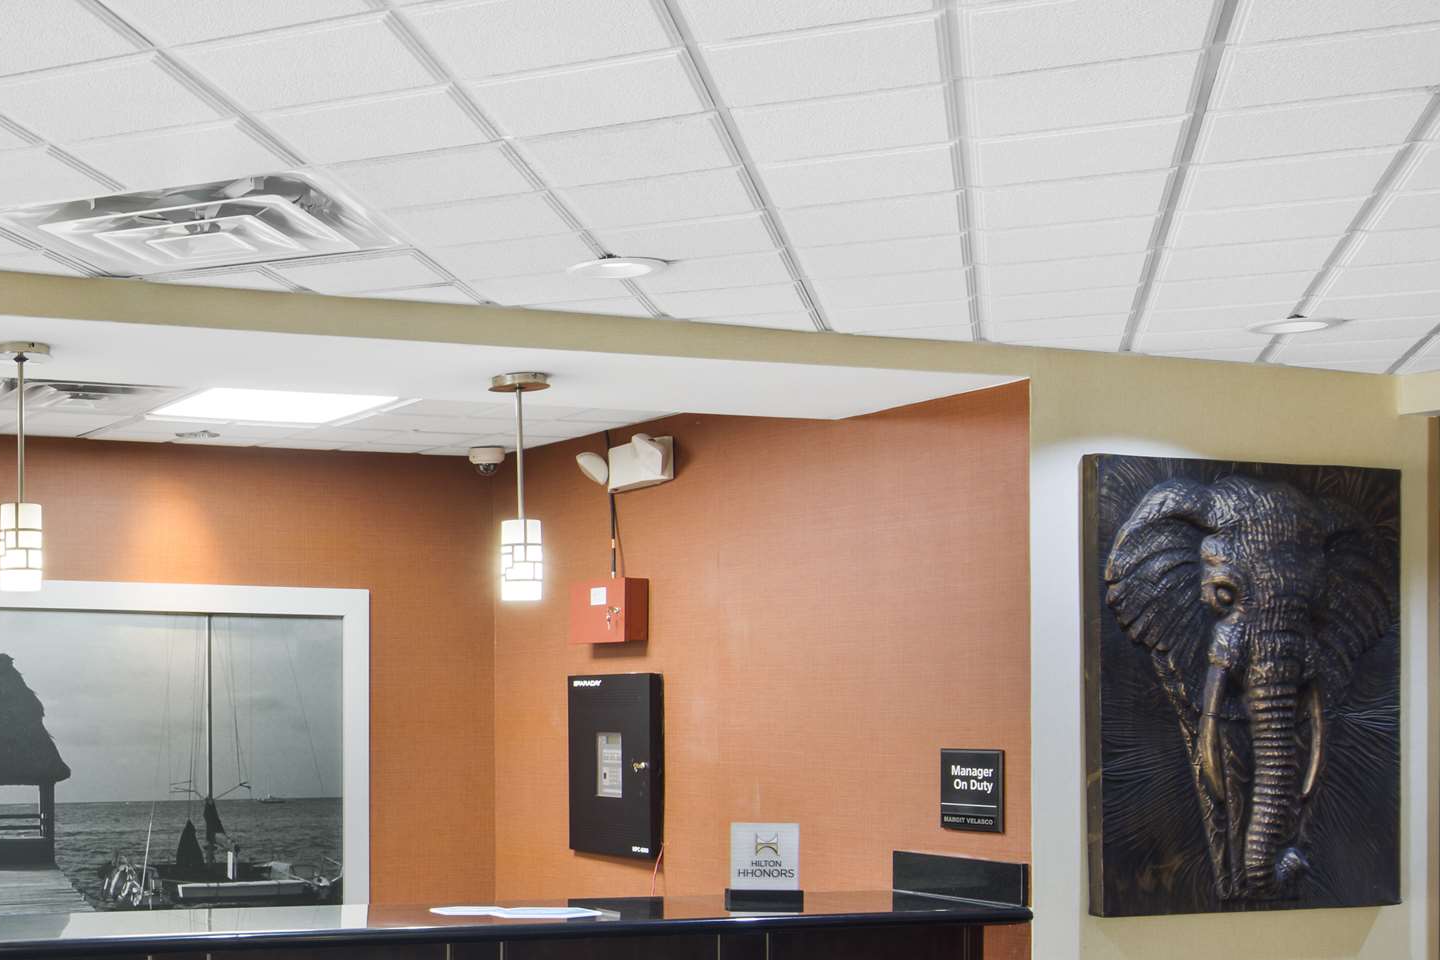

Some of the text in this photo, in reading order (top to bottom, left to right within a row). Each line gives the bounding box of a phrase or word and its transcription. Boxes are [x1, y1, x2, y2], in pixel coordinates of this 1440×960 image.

[951, 765, 994, 779] Manager
[954, 779, 994, 794] On Duty
[738, 869, 795, 878] HHONORS
